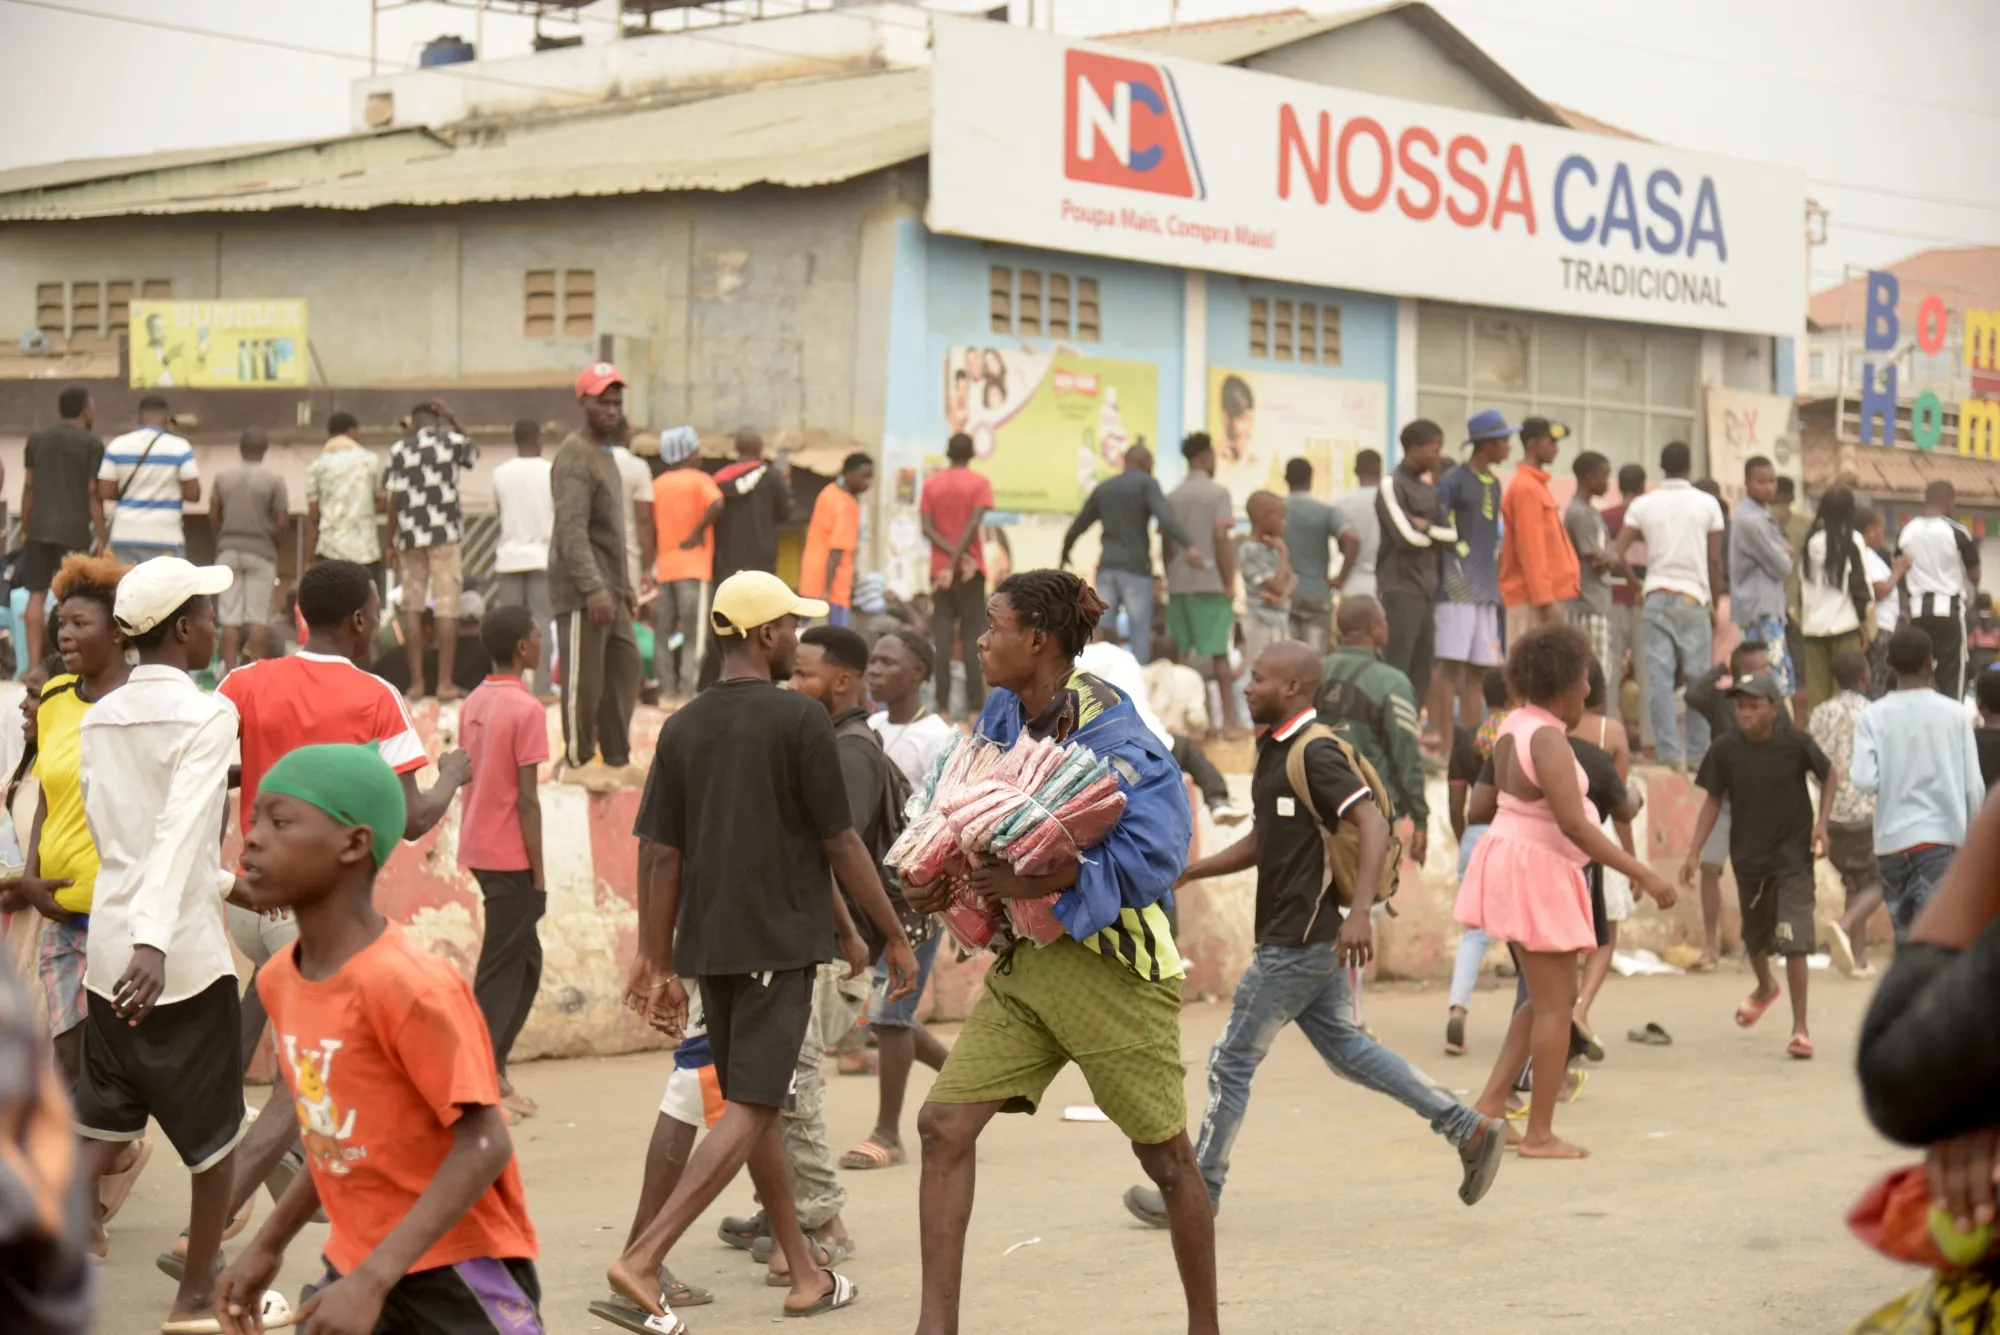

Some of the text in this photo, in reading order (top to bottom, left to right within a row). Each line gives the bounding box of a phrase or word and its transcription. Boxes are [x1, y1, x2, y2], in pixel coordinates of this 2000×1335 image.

[1077, 74, 1164, 172] NC
[1278, 103, 1728, 262] NOSSA CASA
[1061, 199, 1115, 229] Poupa
[1166, 214, 1229, 246] Compra
[1560, 257, 1727, 308] TRADICIONAL
